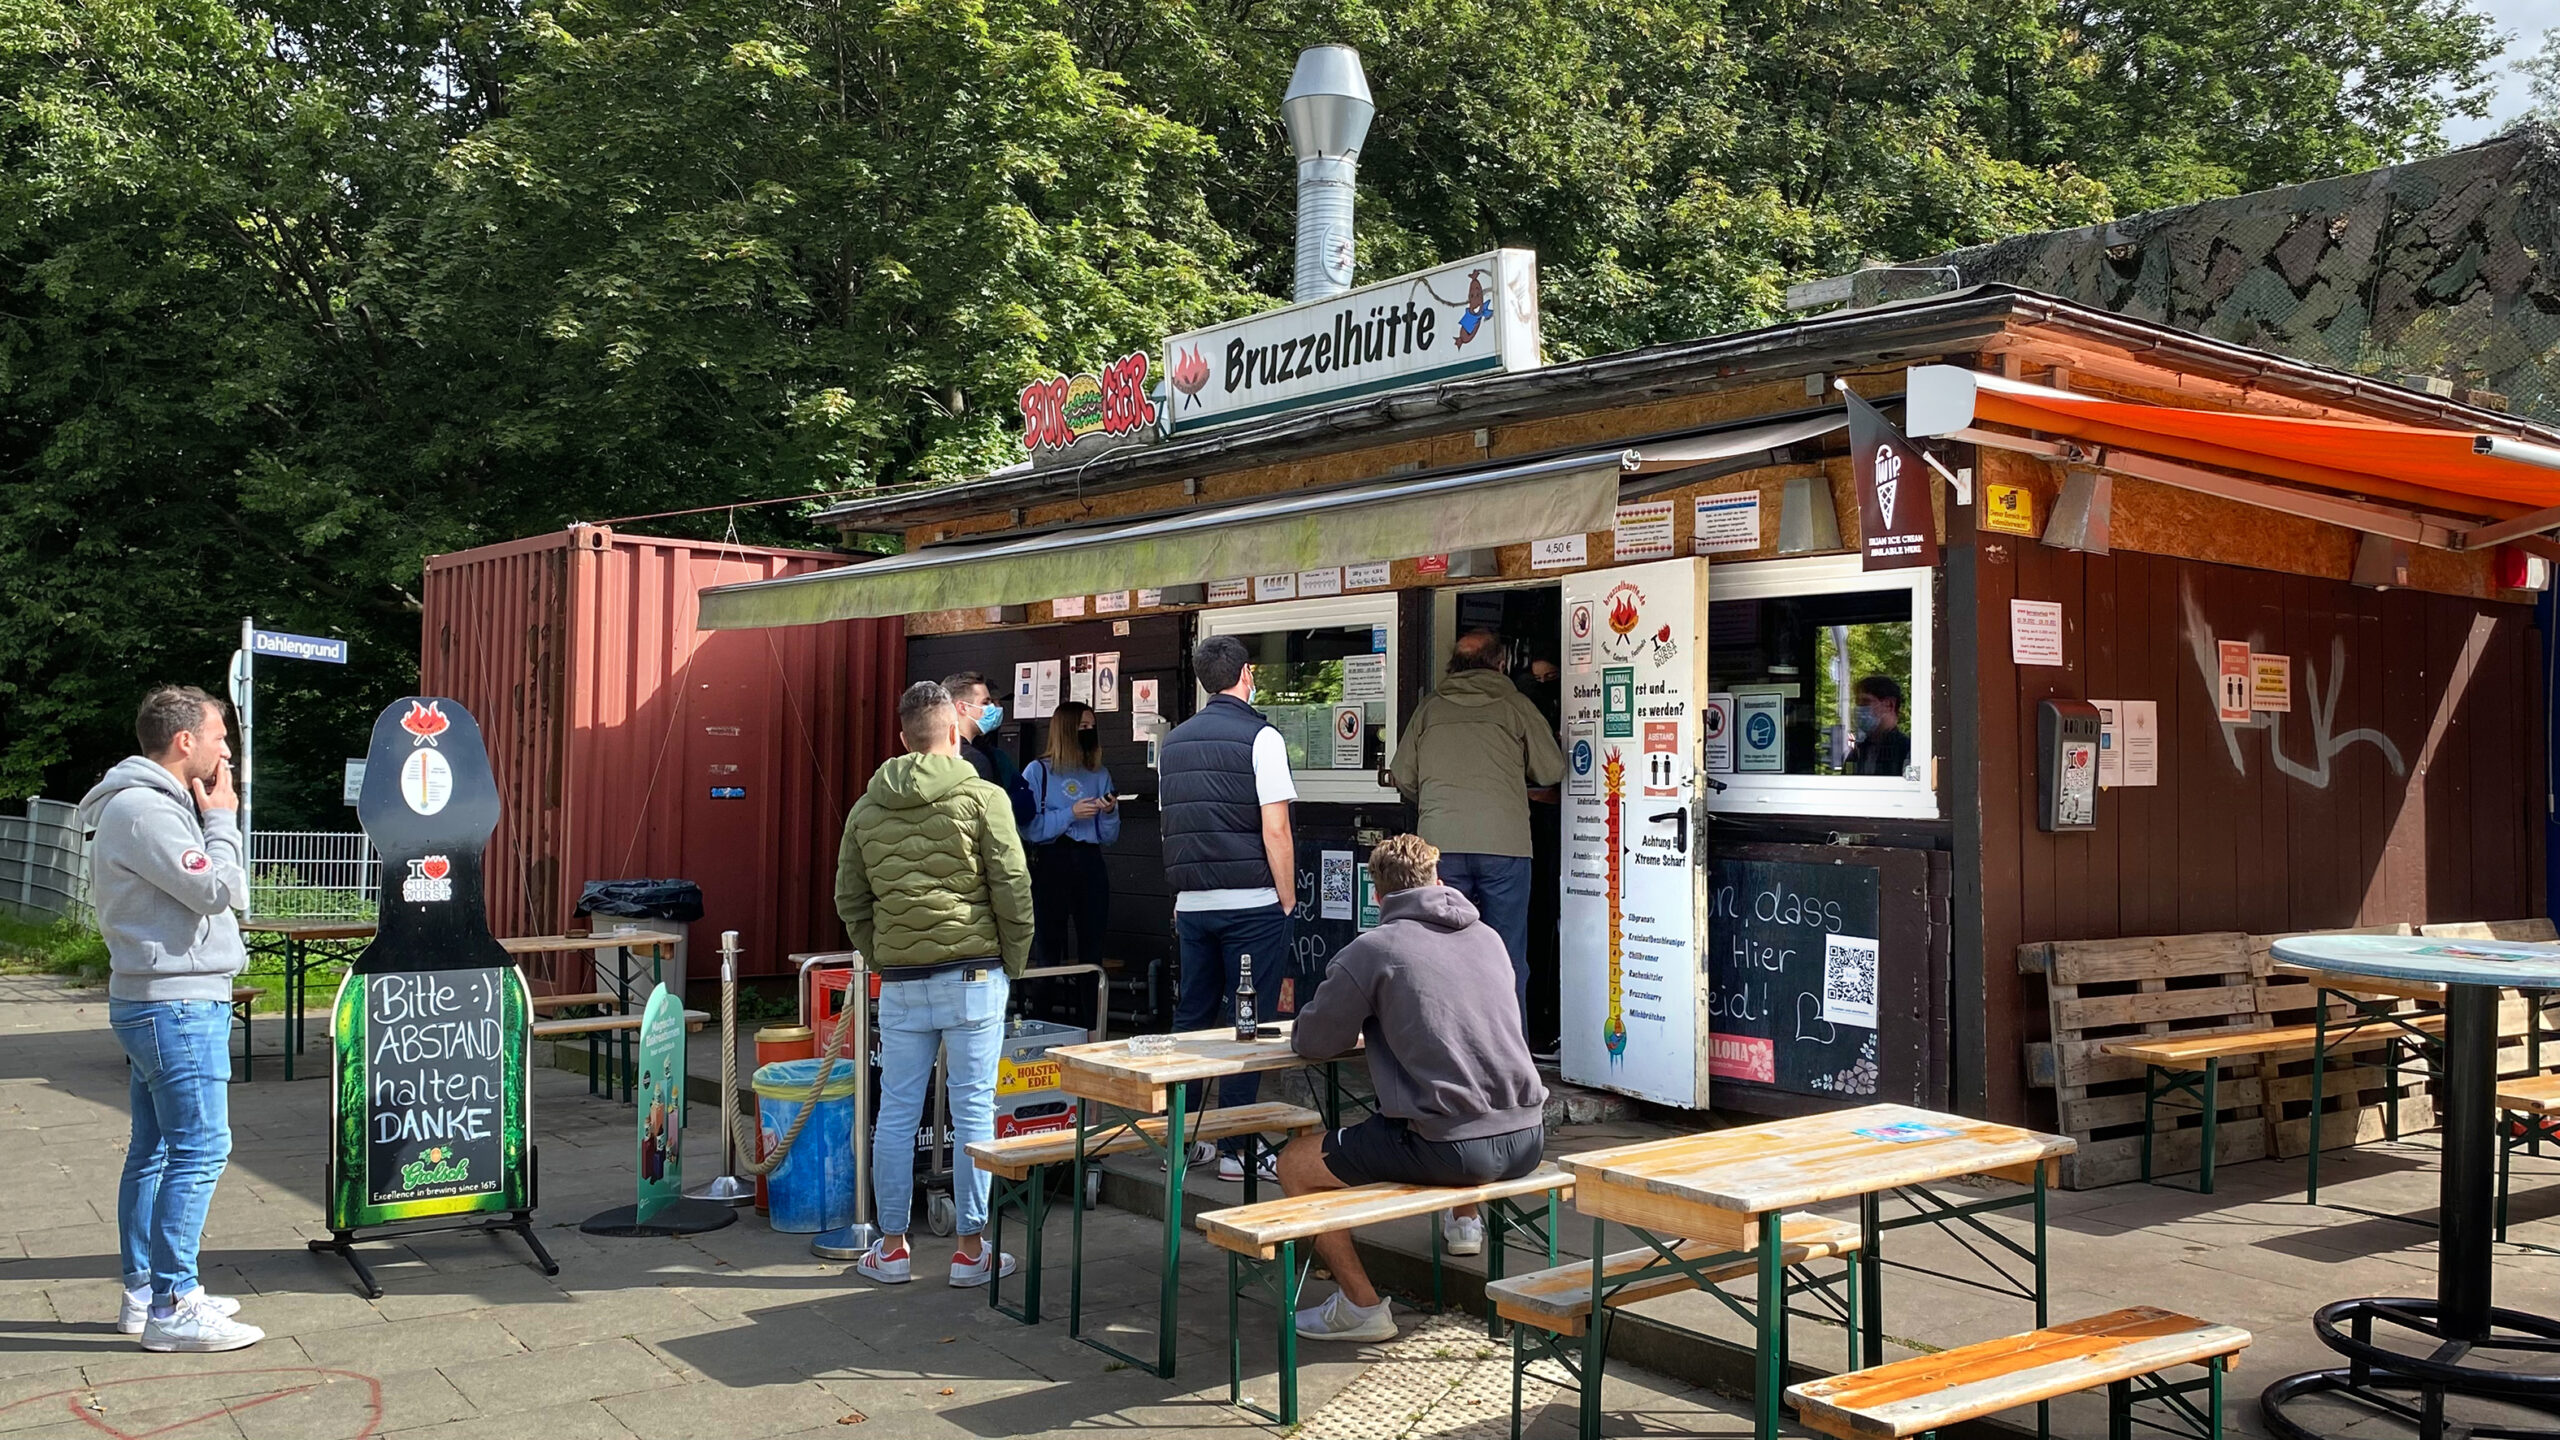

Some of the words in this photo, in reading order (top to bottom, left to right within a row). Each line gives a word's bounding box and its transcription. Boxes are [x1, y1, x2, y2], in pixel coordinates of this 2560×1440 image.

[1225, 301, 1435, 393] Bruzzelhütte
[1546, 542, 1564, 555] 4,50
[1566, 541, 1572, 552] €
[1902, 534, 1924, 543] CREAM
[257, 634, 340, 659] Dahlengrund
[1653, 638, 1677, 661] CURRY
[1654, 647, 1678, 669] WURST
[1605, 674, 1631, 684] MAXIMAL
[1574, 683, 1601, 698] Scharfe
[1649, 680, 1665, 694] und
[1578, 706, 1590, 719] wie
[1638, 708, 1647, 717] es
[1649, 702, 1685, 717] werden?
[1648, 733, 1675, 741] ABSTAND
[1642, 835, 1671, 849] Achtung
[1635, 853, 1660, 865] Xtreme
[1662, 855, 1686, 867] Scharf
[409, 861, 422, 880] I
[405, 880, 449, 891] CURRY
[405, 890, 450, 900] WURST
[1755, 882, 1842, 933] dass
[1733, 934, 1797, 973] Hier
[372, 975, 462, 1024] Bitte
[374, 1018, 503, 1065] ABSTAND
[1017, 1063, 1061, 1079] HOLSTEN
[375, 1068, 498, 1107] halten
[1028, 1075, 1053, 1088] EDEL
[374, 1106, 492, 1143] DANKE
[401, 1158, 470, 1190] Grolsch
[373, 1191, 415, 1201] Excellence
[417, 1188, 425, 1196] in
[426, 1186, 457, 1197] brewing
[459, 1184, 479, 1193] since
[481, 1180, 497, 1190] 1615
